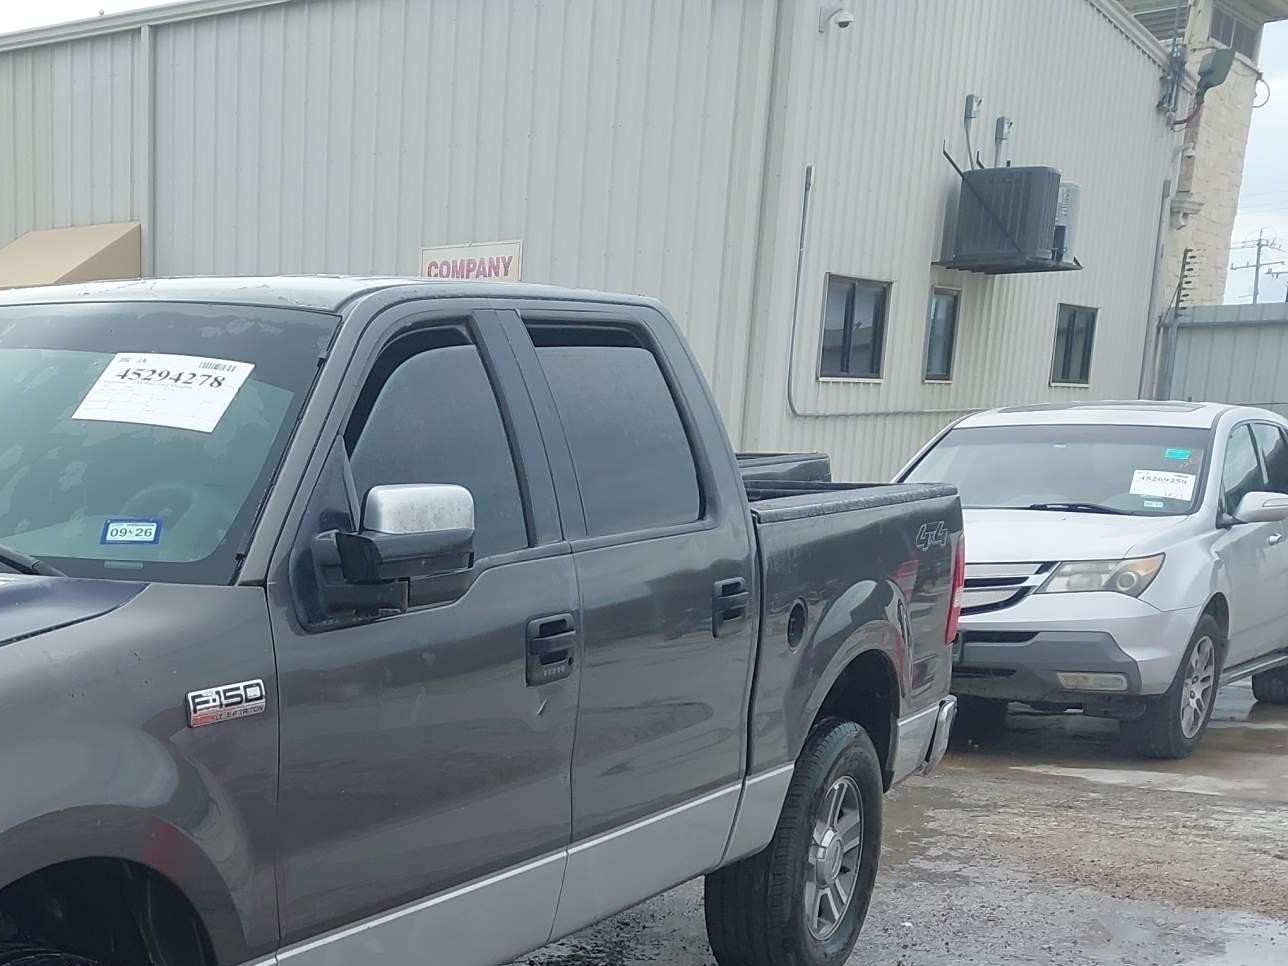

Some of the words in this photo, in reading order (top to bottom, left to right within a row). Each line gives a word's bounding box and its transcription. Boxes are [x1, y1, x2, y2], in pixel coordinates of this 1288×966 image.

[427, 255, 514, 279] COMPANY
[115, 367, 226, 389] 45294278
[190, 682, 265, 714] F-150
